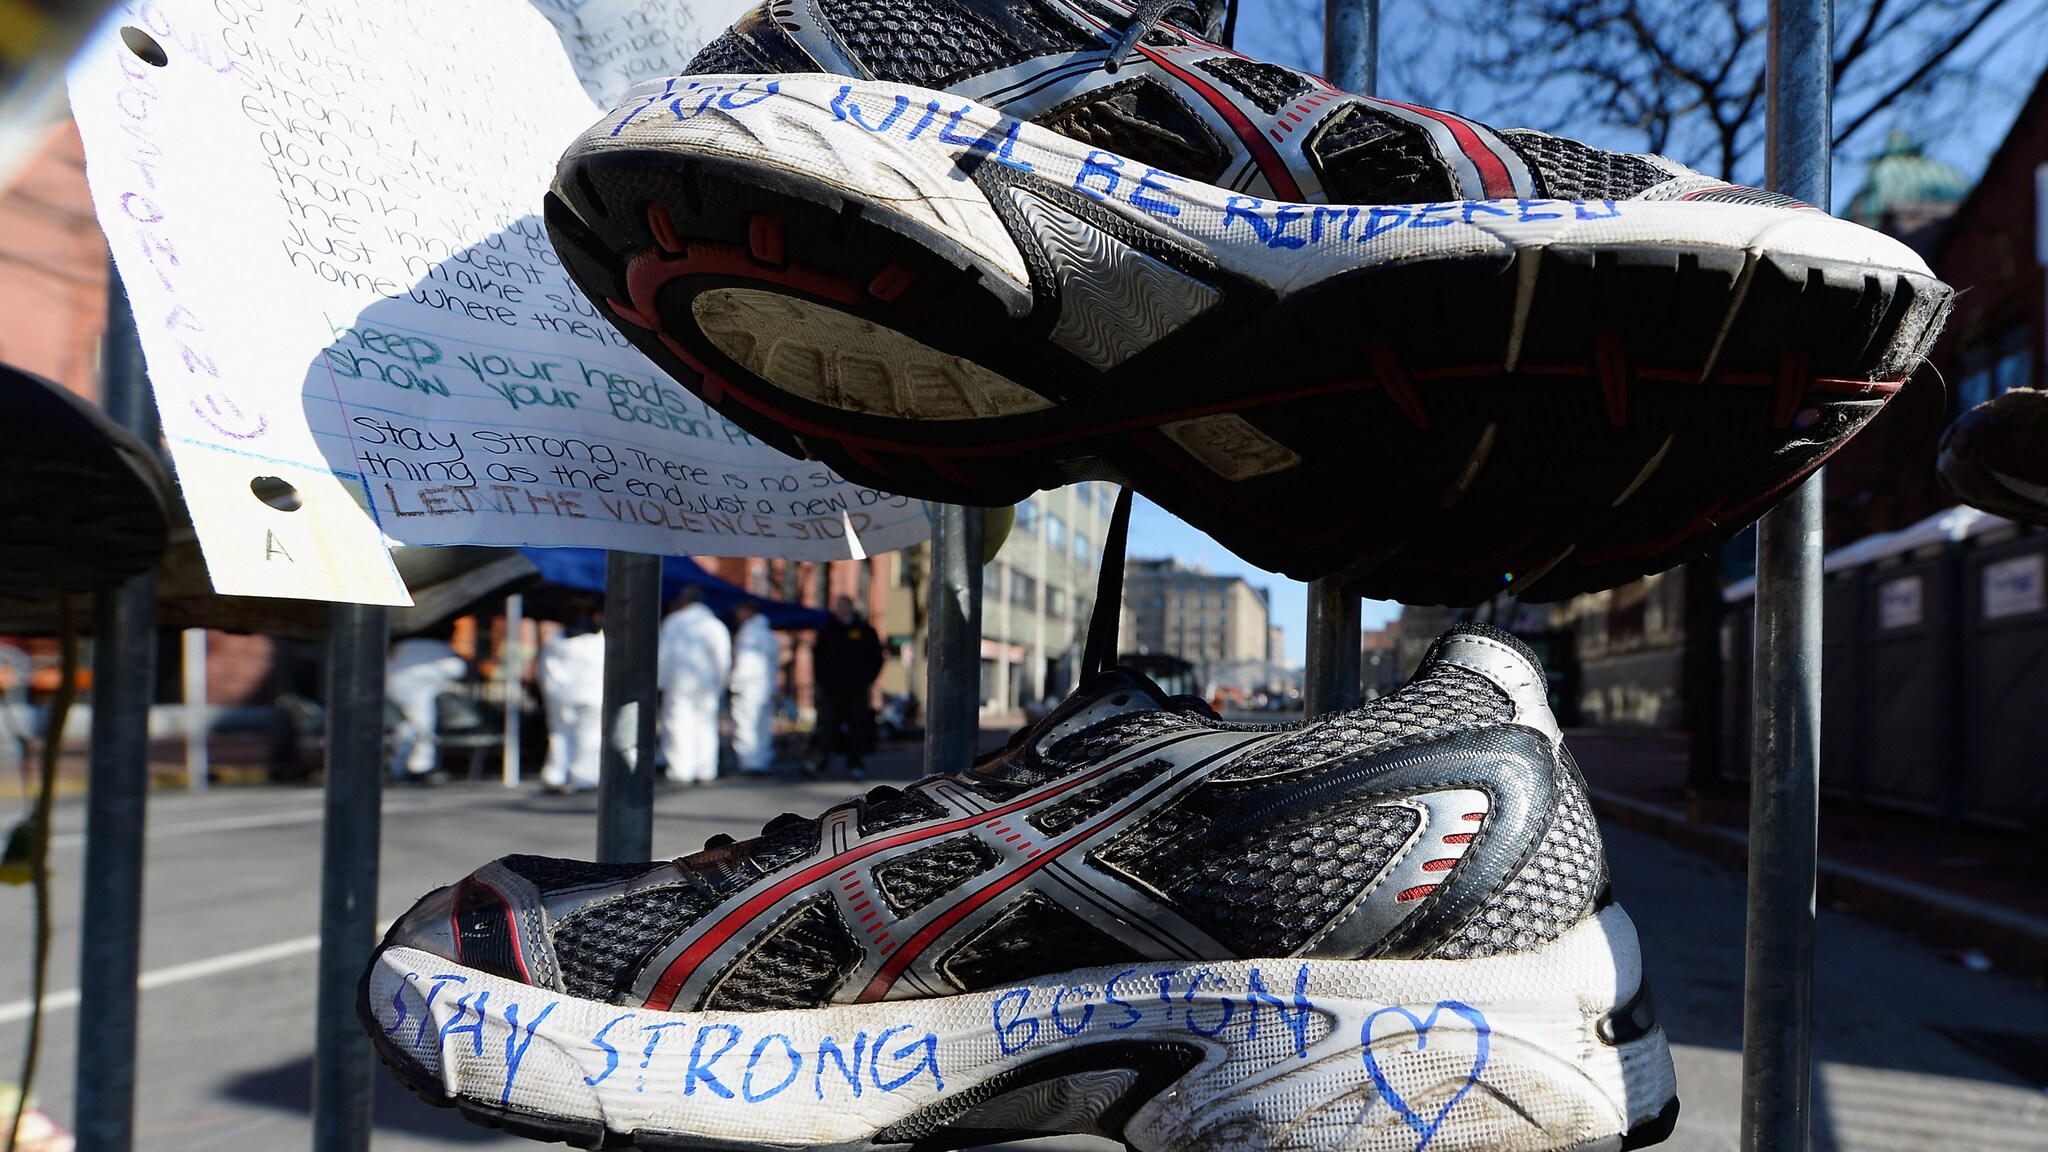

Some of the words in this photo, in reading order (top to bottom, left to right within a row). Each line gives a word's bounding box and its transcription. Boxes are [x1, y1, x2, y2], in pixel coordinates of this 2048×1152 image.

[610, 76, 781, 137] YOU
[830, 84, 1035, 173] WILL
[1072, 149, 1190, 218] BE
[275, 189, 361, 235] the
[405, 282, 517, 326] where
[458, 351, 563, 384] your
[353, 416, 465, 464] Stay
[722, 472, 749, 491] is
[761, 474, 799, 493] no
[809, 470, 847, 489] su
[358, 450, 477, 488] thing
[486, 462, 539, 484] as
[550, 464, 613, 493] the
[756, 499, 775, 514] a
[789, 492, 848, 516] new
[384, 481, 478, 518] LET
[489, 483, 588, 520] THE
[599, 493, 777, 539] VIOLENCE
[265, 528, 295, 564] A
[385, 970, 561, 1106] STAY
[584, 1013, 945, 1104] STRONG
[993, 961, 1317, 1060] BOSTON
